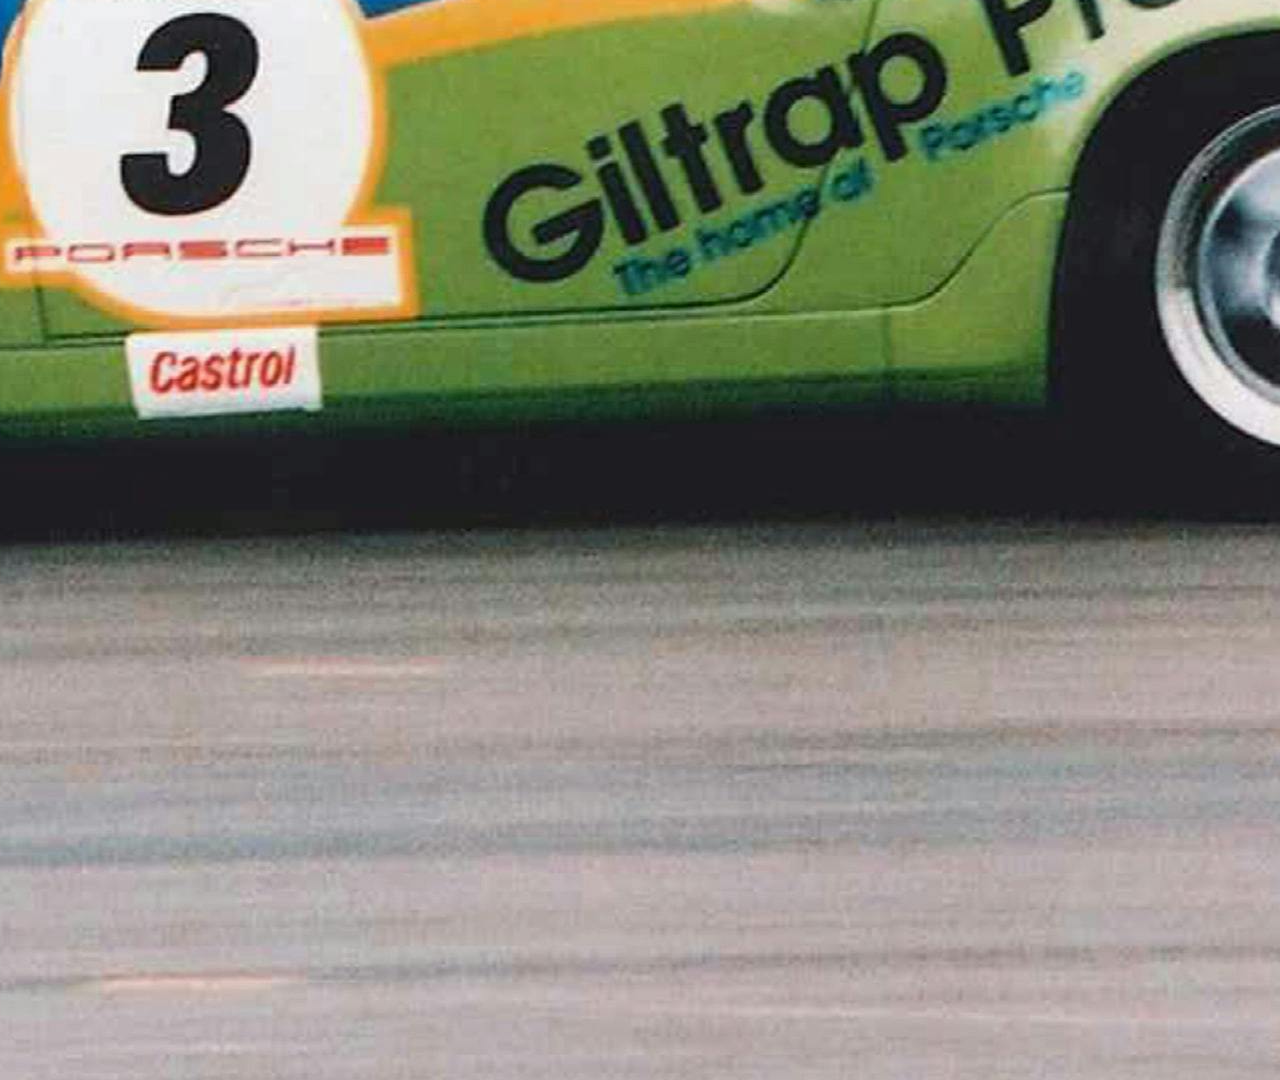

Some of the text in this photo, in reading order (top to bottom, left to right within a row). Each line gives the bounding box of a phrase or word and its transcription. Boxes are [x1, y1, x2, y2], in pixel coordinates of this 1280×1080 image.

[119, 11, 261, 217] 3
[482, 29, 948, 284] Giltrap
[614, 247, 691, 295] The
[696, 187, 820, 258] home
[921, 69, 1085, 160] Porsche
[14, 236, 391, 264] PORSCHE
[149, 344, 296, 395] Castrol
